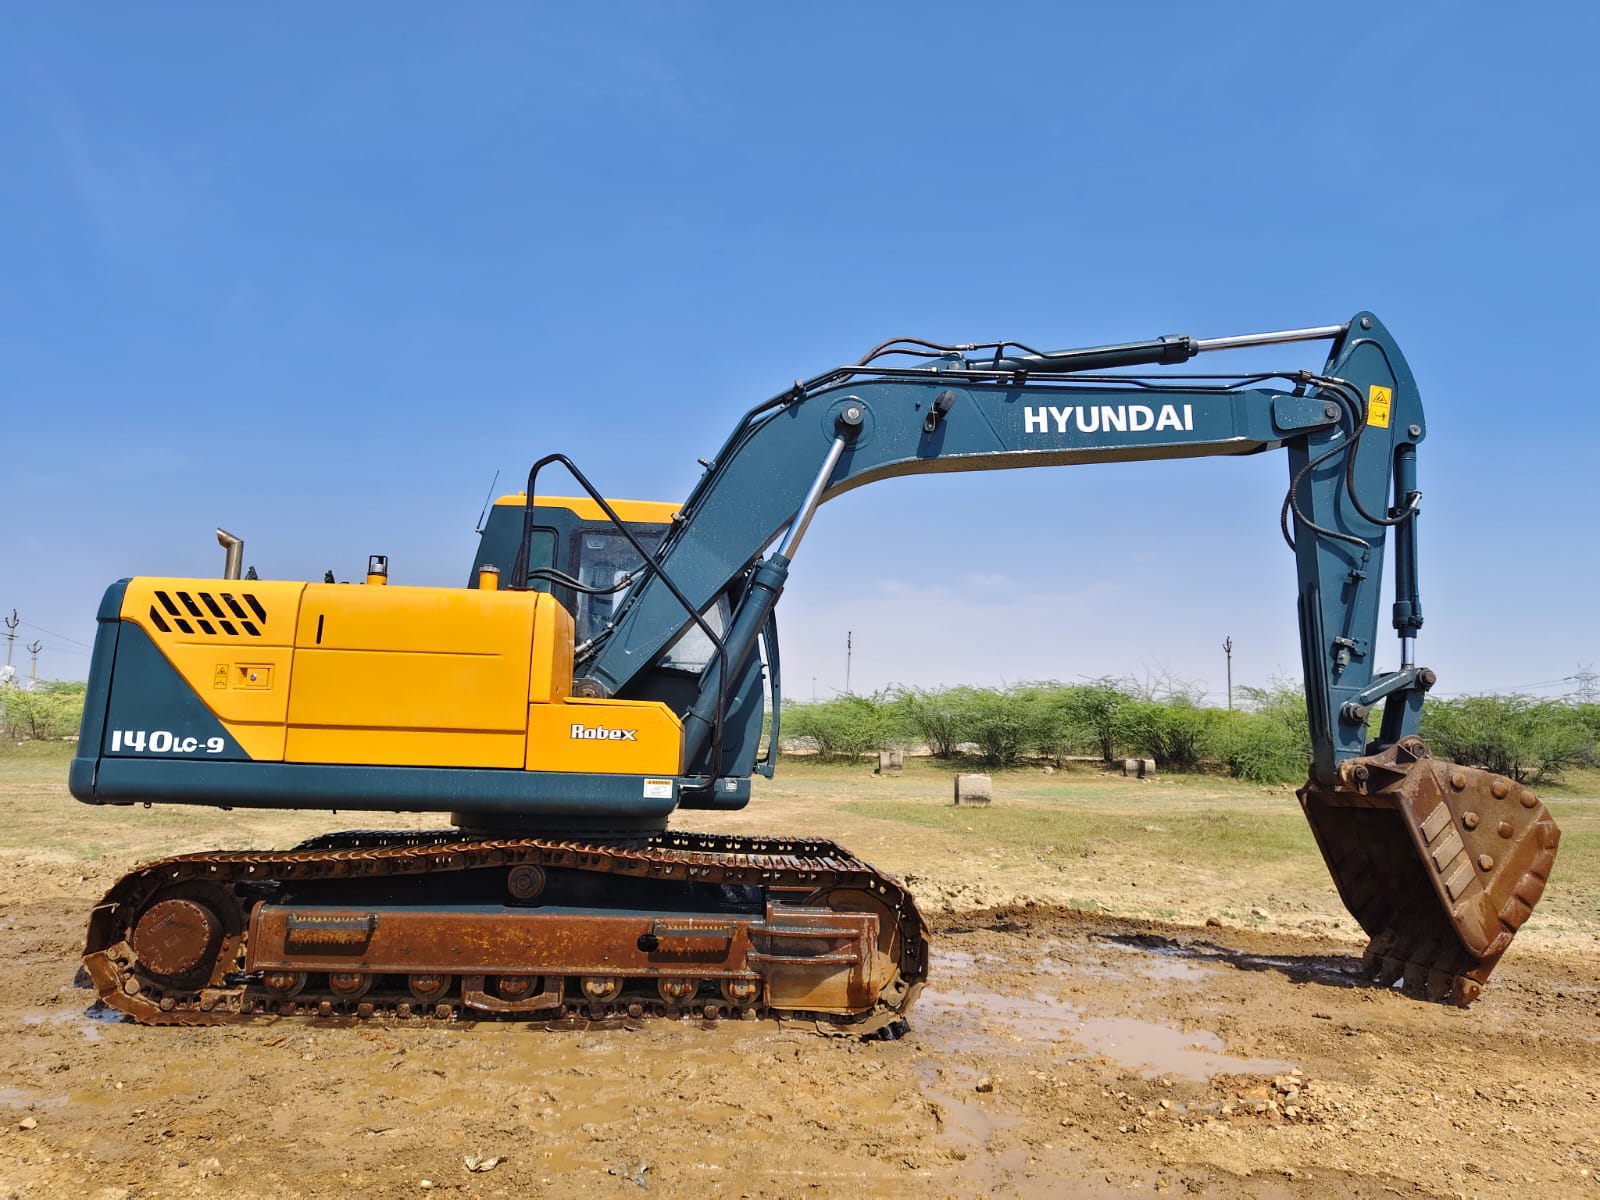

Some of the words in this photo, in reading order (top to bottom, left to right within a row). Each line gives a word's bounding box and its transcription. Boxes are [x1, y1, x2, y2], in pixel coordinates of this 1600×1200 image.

[1024, 404, 1194, 433] HYUNDAI
[111, 730, 225, 753] 140LC-9
[570, 723, 639, 742] Robex
